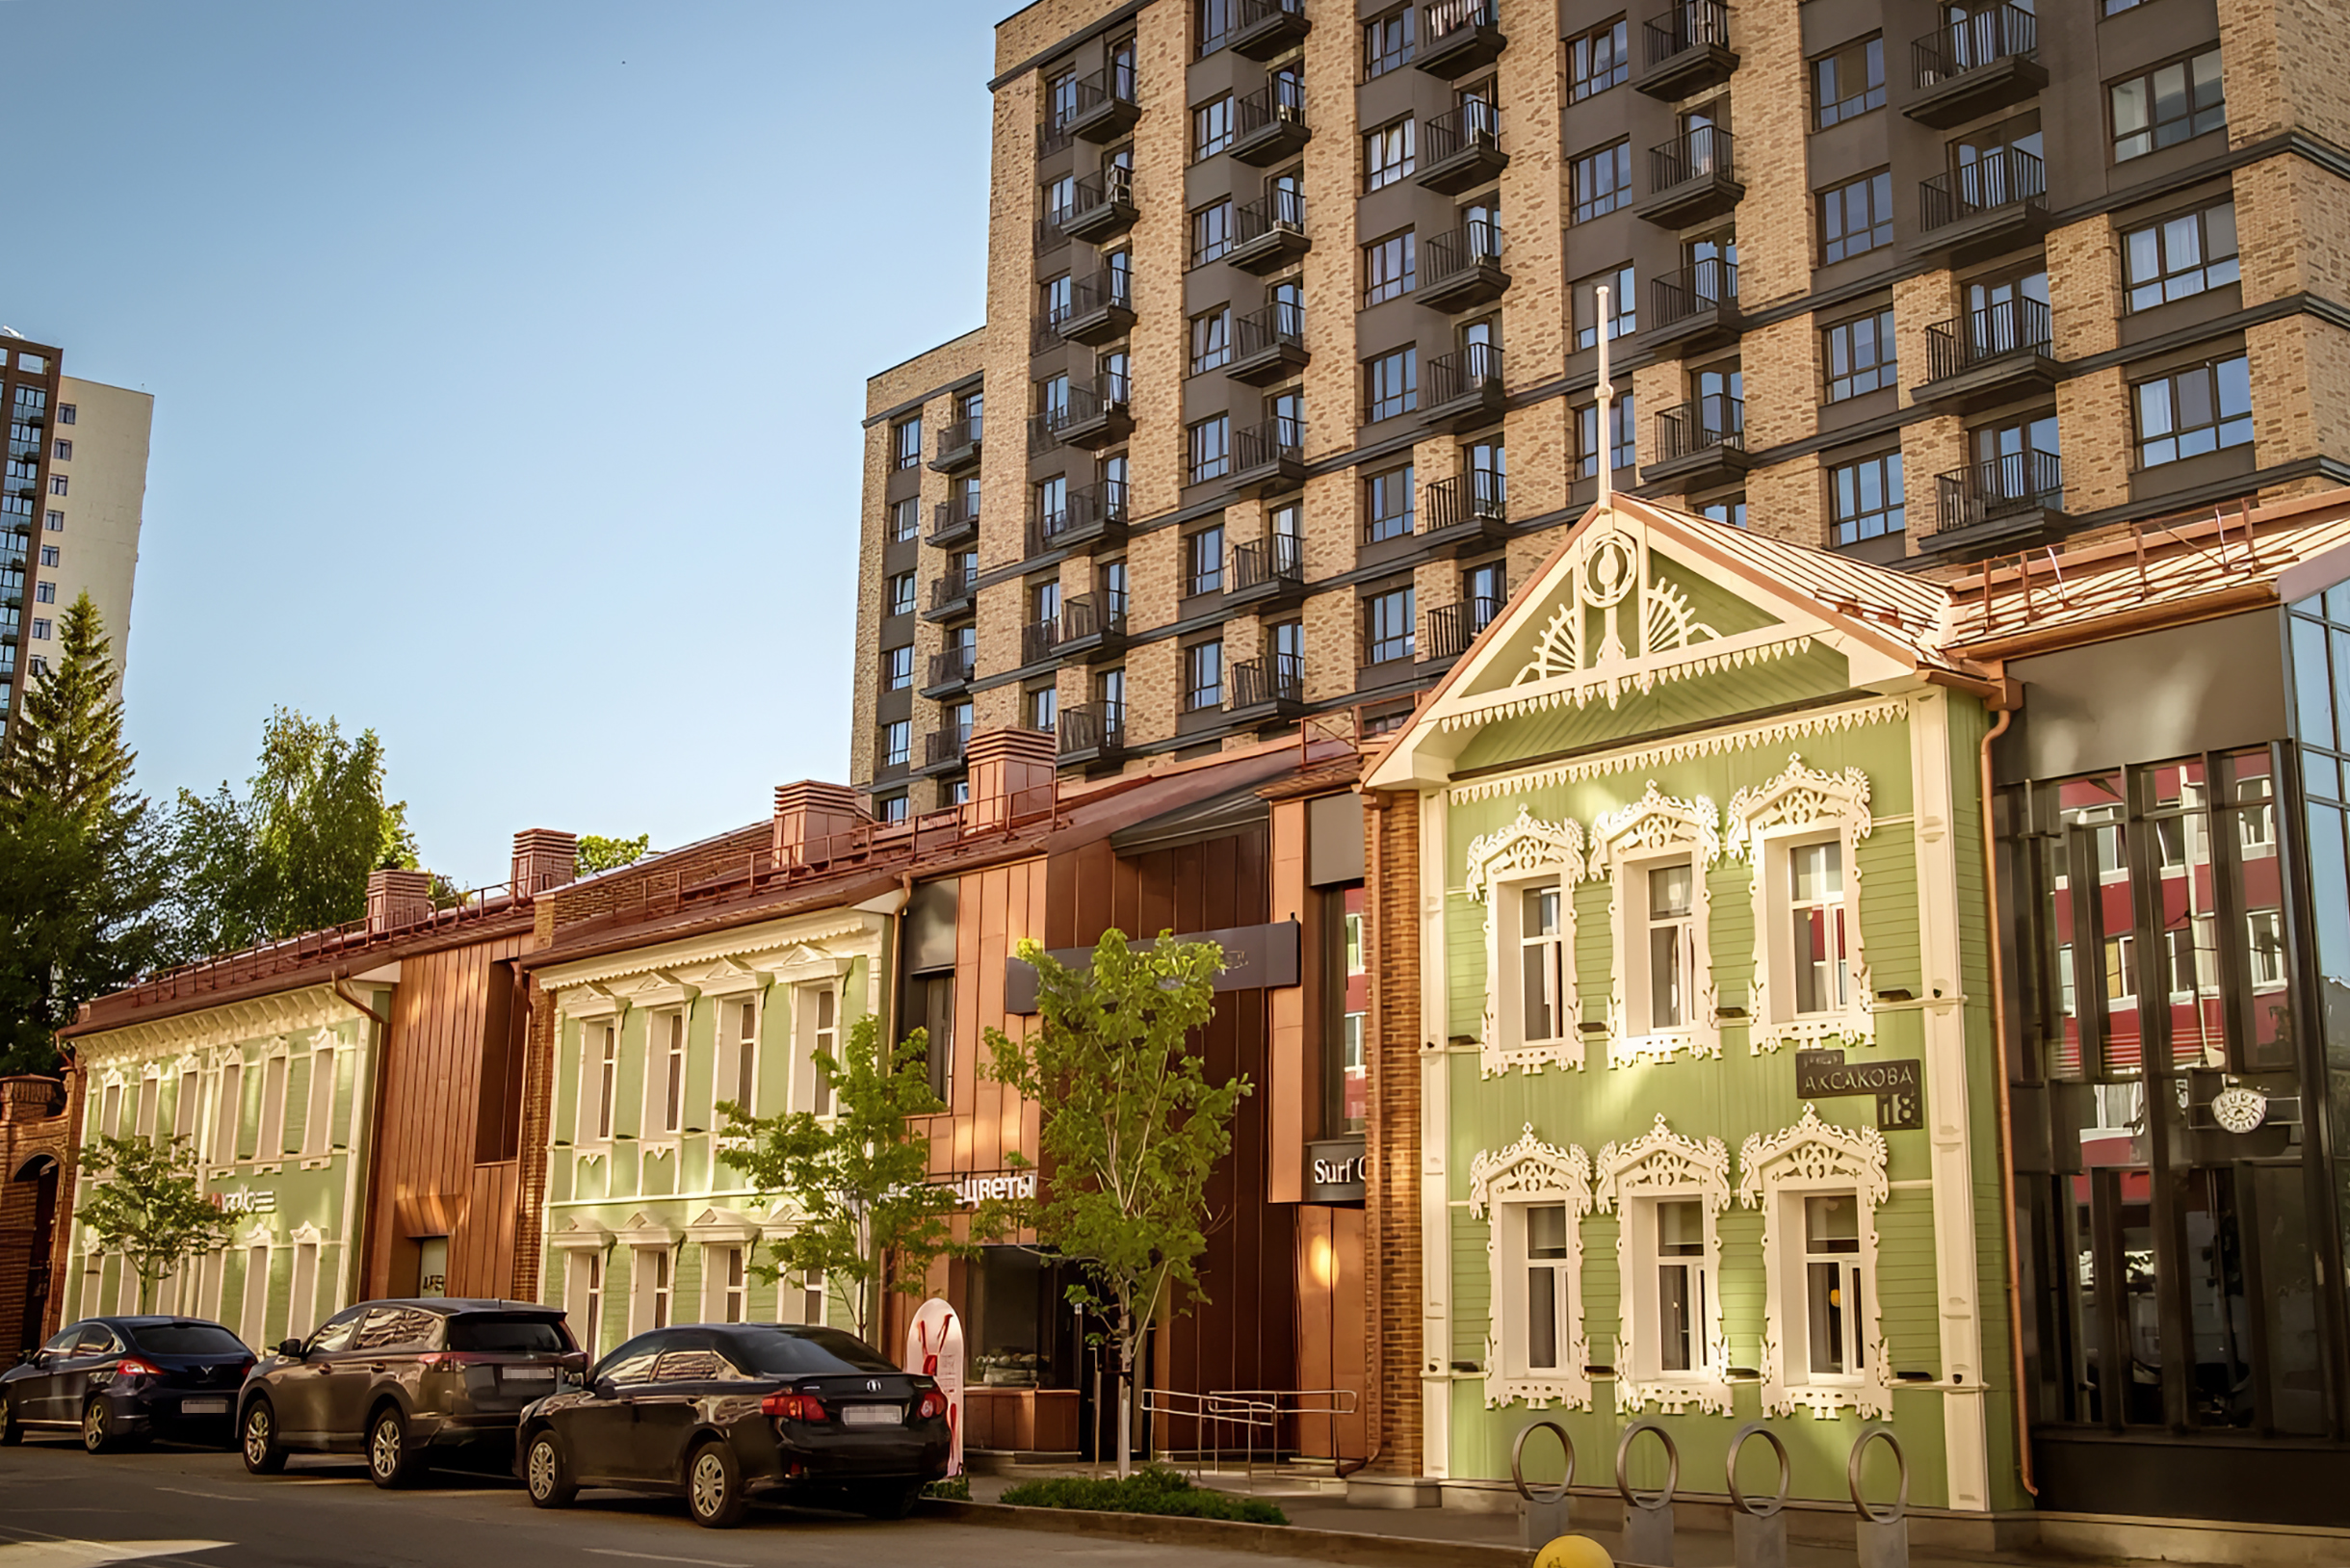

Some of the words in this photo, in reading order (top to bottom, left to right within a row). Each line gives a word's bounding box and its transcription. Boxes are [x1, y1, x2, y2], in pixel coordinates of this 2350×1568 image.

[1804, 1065, 1914, 1091] АКСАКОВА
[1882, 1093, 1915, 1126] 18
[1315, 1158, 1354, 1184] Surf
